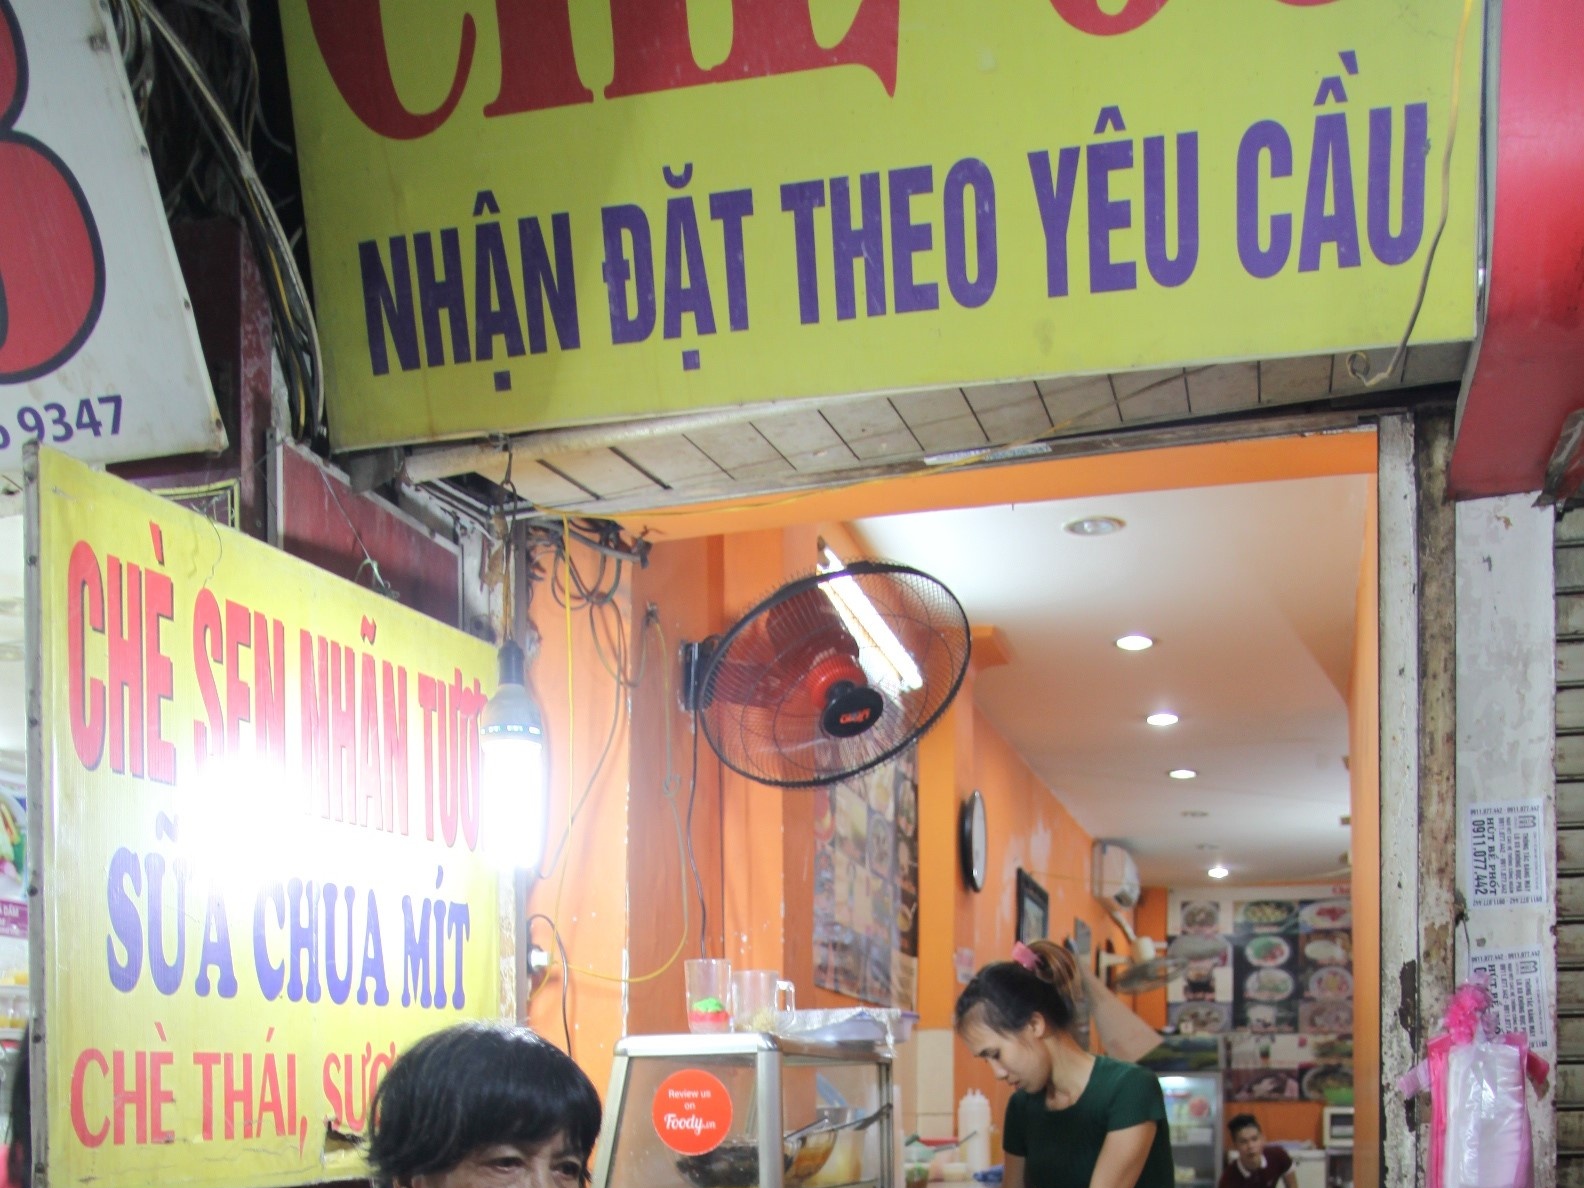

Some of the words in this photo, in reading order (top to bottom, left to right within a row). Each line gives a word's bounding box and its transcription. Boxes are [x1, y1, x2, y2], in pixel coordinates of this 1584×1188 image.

[358, 191, 581, 392] NHẬN
[601, 163, 754, 371] ĐẶT
[780, 157, 998, 325] THEO
[1026, 105, 1199, 298] YÊU
[1236, 50, 1429, 279] CẦU
[68, 519, 177, 787] CHÈ
[300, 614, 409, 836] NHÃN
[1472, 819, 1488, 895] 0911.077.442
[253, 877, 389, 1006] CHUA
[401, 864, 470, 1010] MÍT
[70, 1021, 176, 1148] CHÈ
[193, 1027, 308, 1158] THÁI,
[667, 1088, 699, 1099] Review
[700, 1090, 712, 1098] us
[684, 1102, 696, 1110] on
